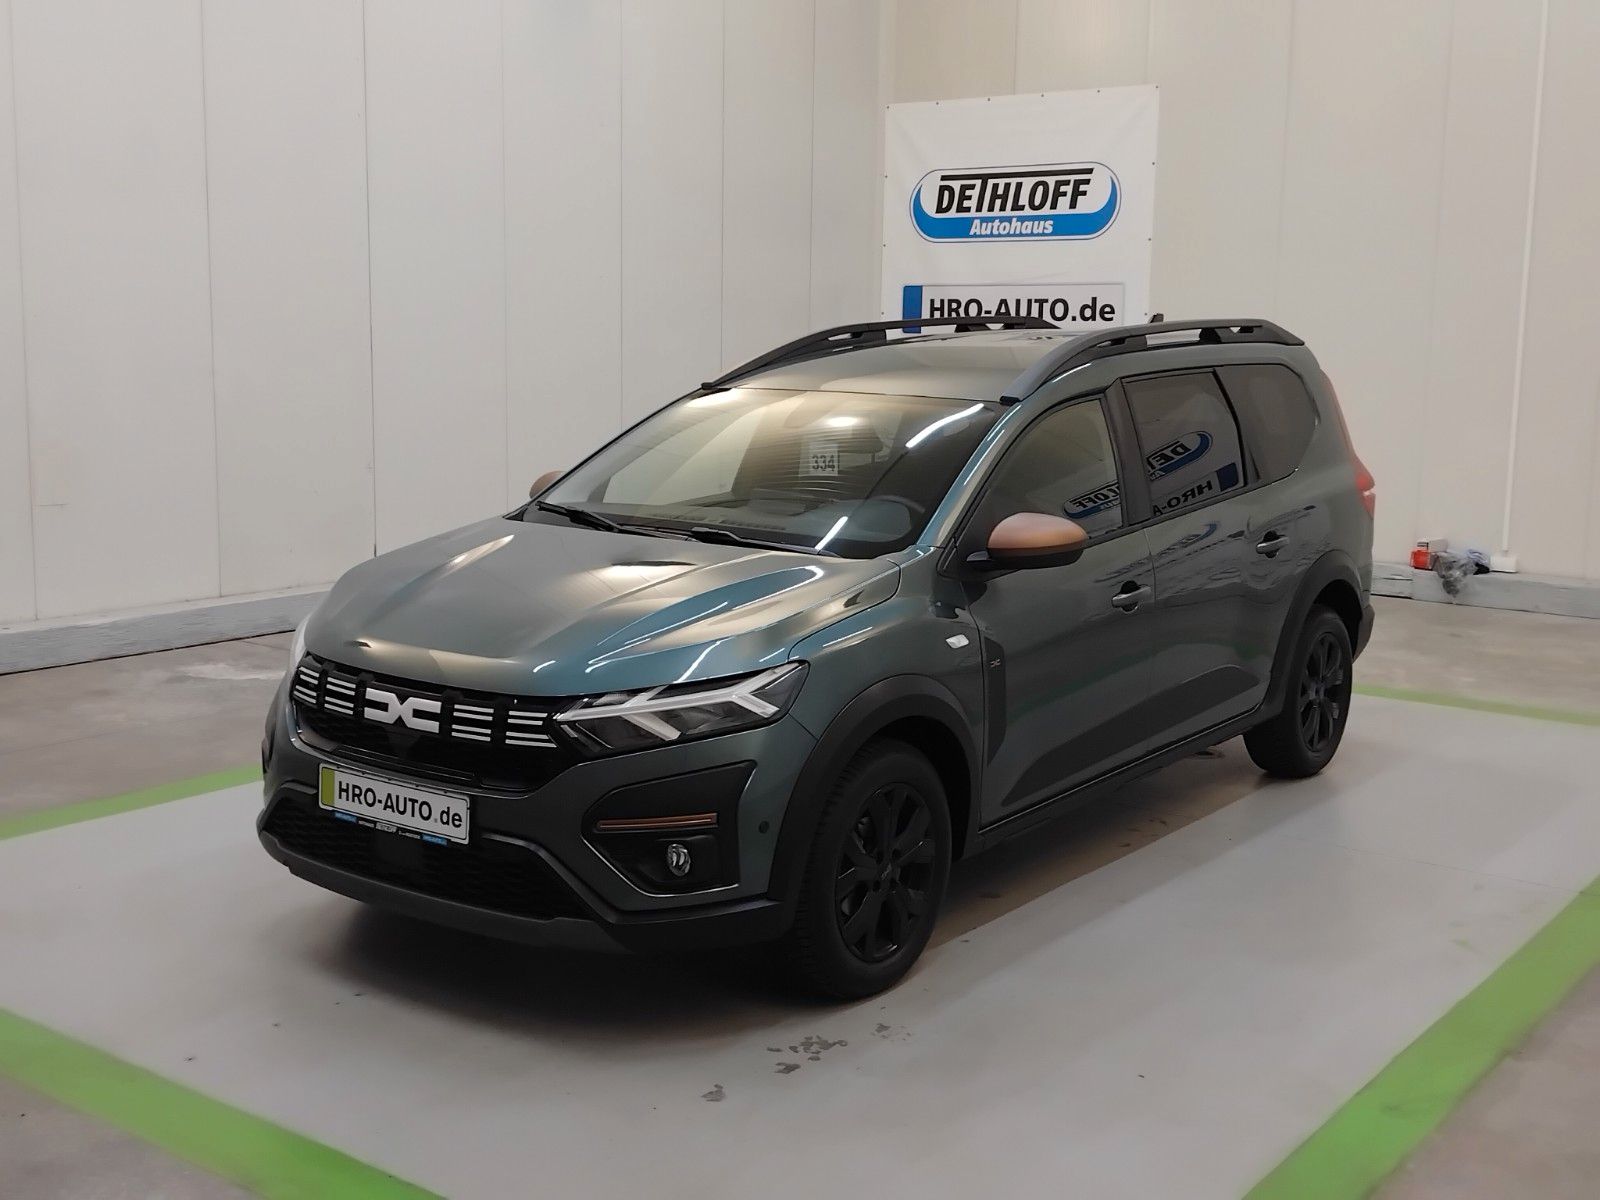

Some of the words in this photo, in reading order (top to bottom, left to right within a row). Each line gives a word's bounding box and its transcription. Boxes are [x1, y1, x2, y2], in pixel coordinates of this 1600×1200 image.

[935, 168, 1094, 214] DETHLOFF
[969, 217, 1053, 236] Autohaus
[929, 296, 1116, 322] HRO-AUTO.de
[812, 454, 836, 472] 334
[338, 780, 463, 829] HRO-AUTO.de
